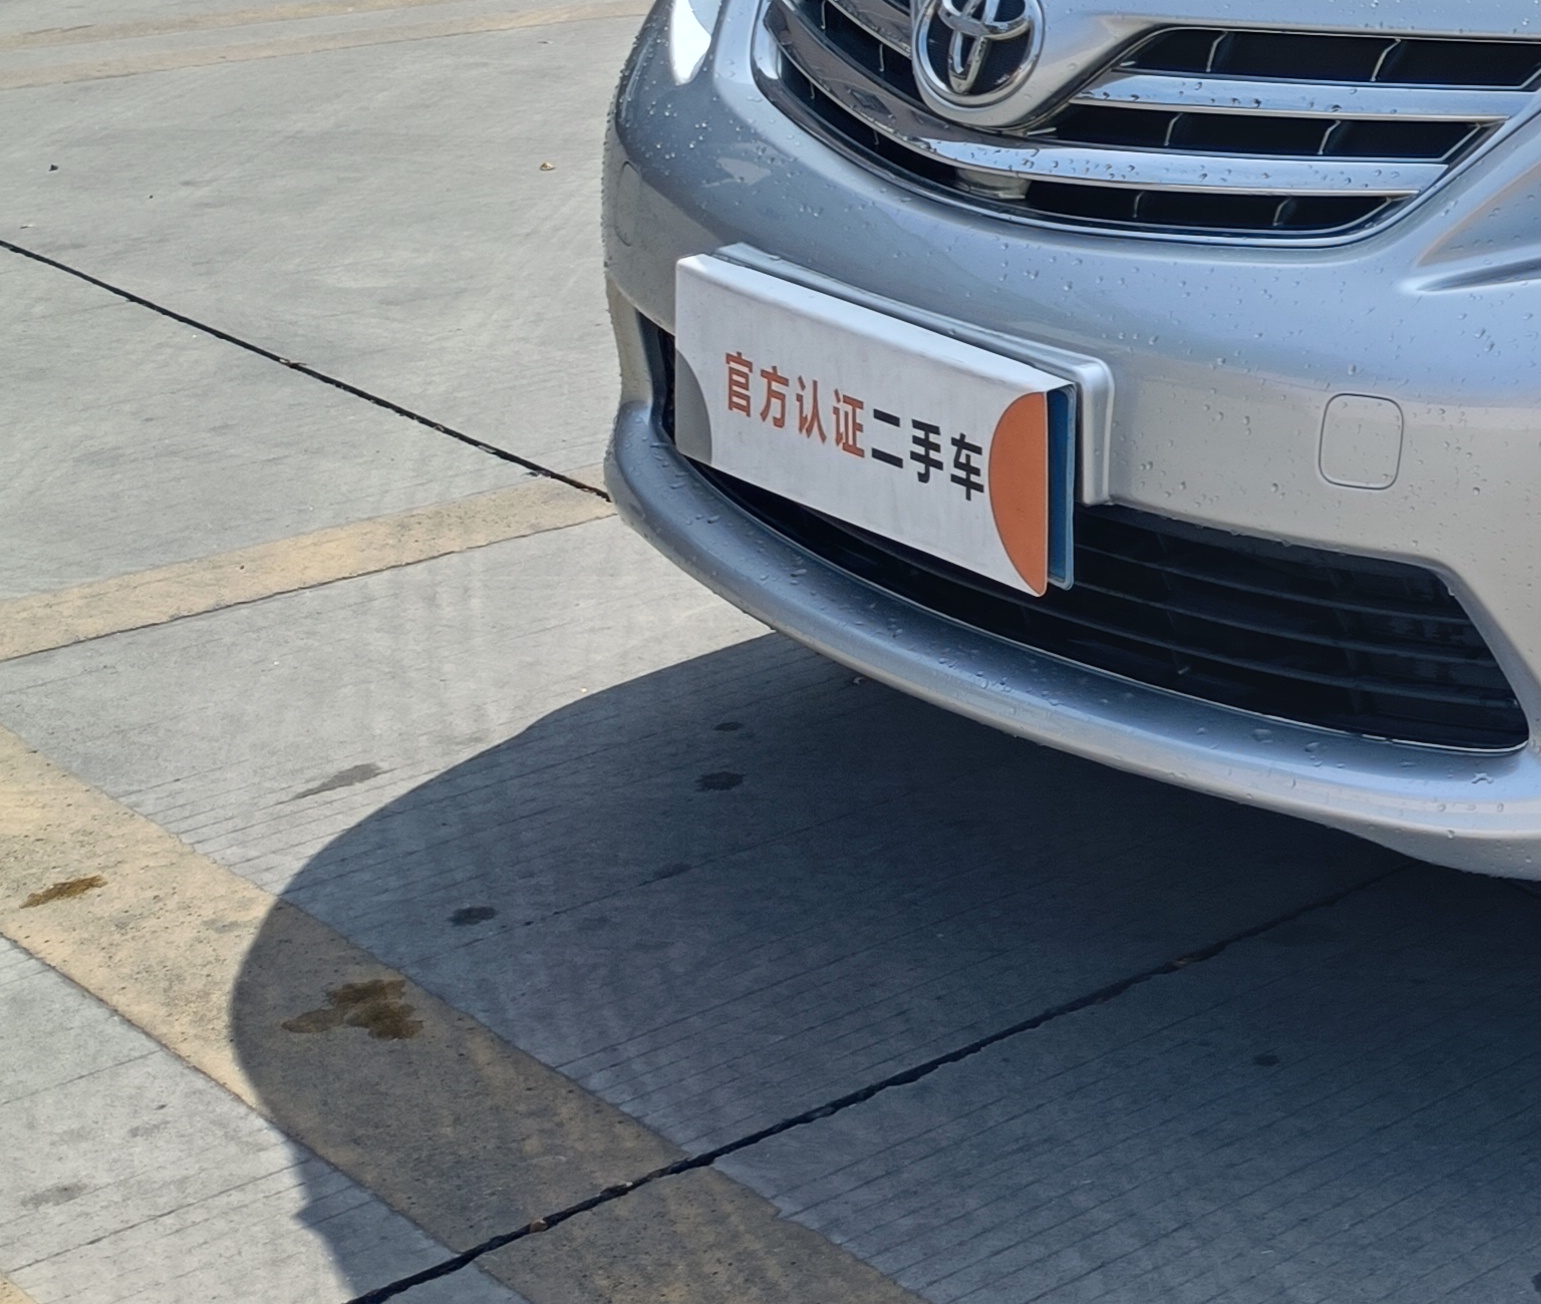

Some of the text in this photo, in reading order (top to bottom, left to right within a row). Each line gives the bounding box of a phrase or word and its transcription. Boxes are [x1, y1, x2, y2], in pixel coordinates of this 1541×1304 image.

[725, 351, 985, 502] 官方认证二手车
